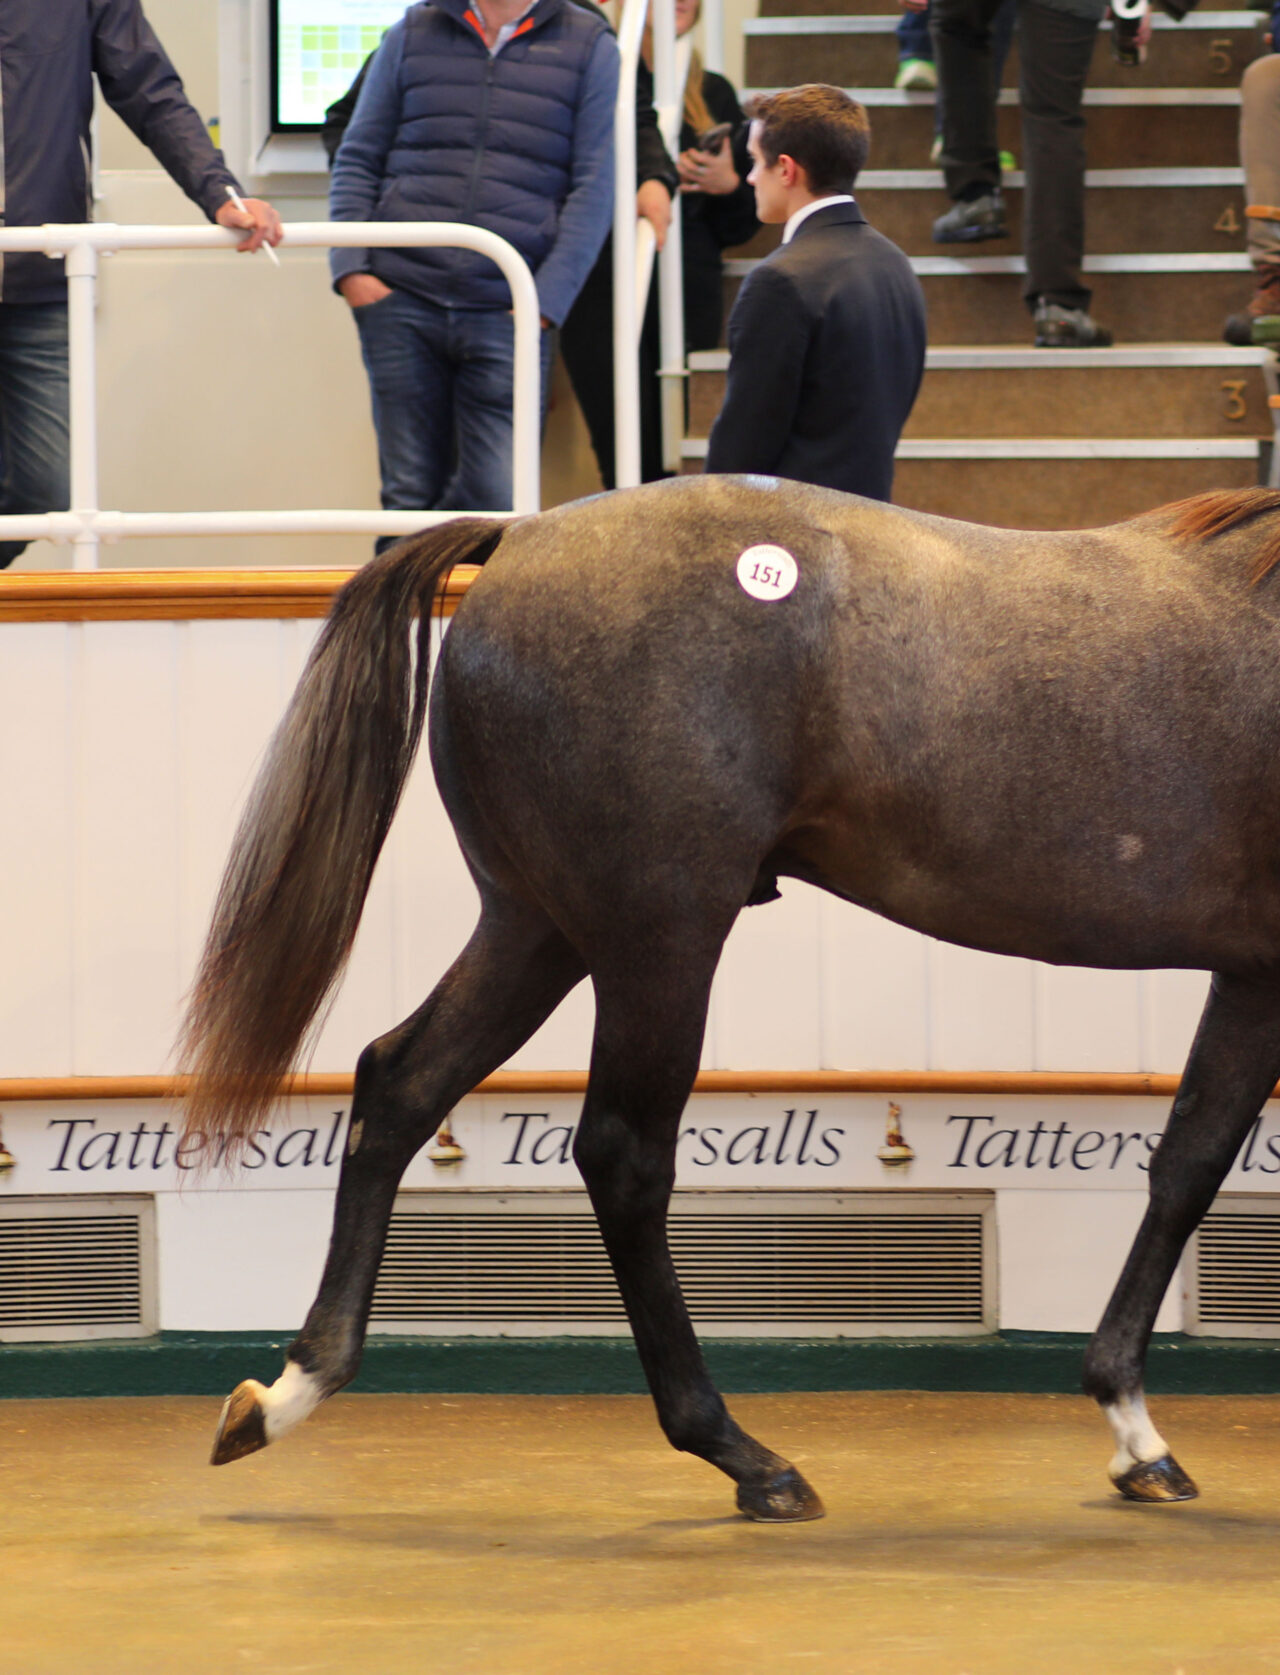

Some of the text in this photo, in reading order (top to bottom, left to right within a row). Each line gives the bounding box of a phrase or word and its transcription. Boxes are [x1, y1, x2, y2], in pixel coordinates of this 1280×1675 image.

[1209, 39, 1232, 74] 5
[1213, 203, 1239, 235] 4
[1221, 380, 1247, 419] 3
[749, 563, 782, 588] 151
[48, 1110, 345, 1172] Tattersal
[501, 1108, 846, 1167] Tasalls
